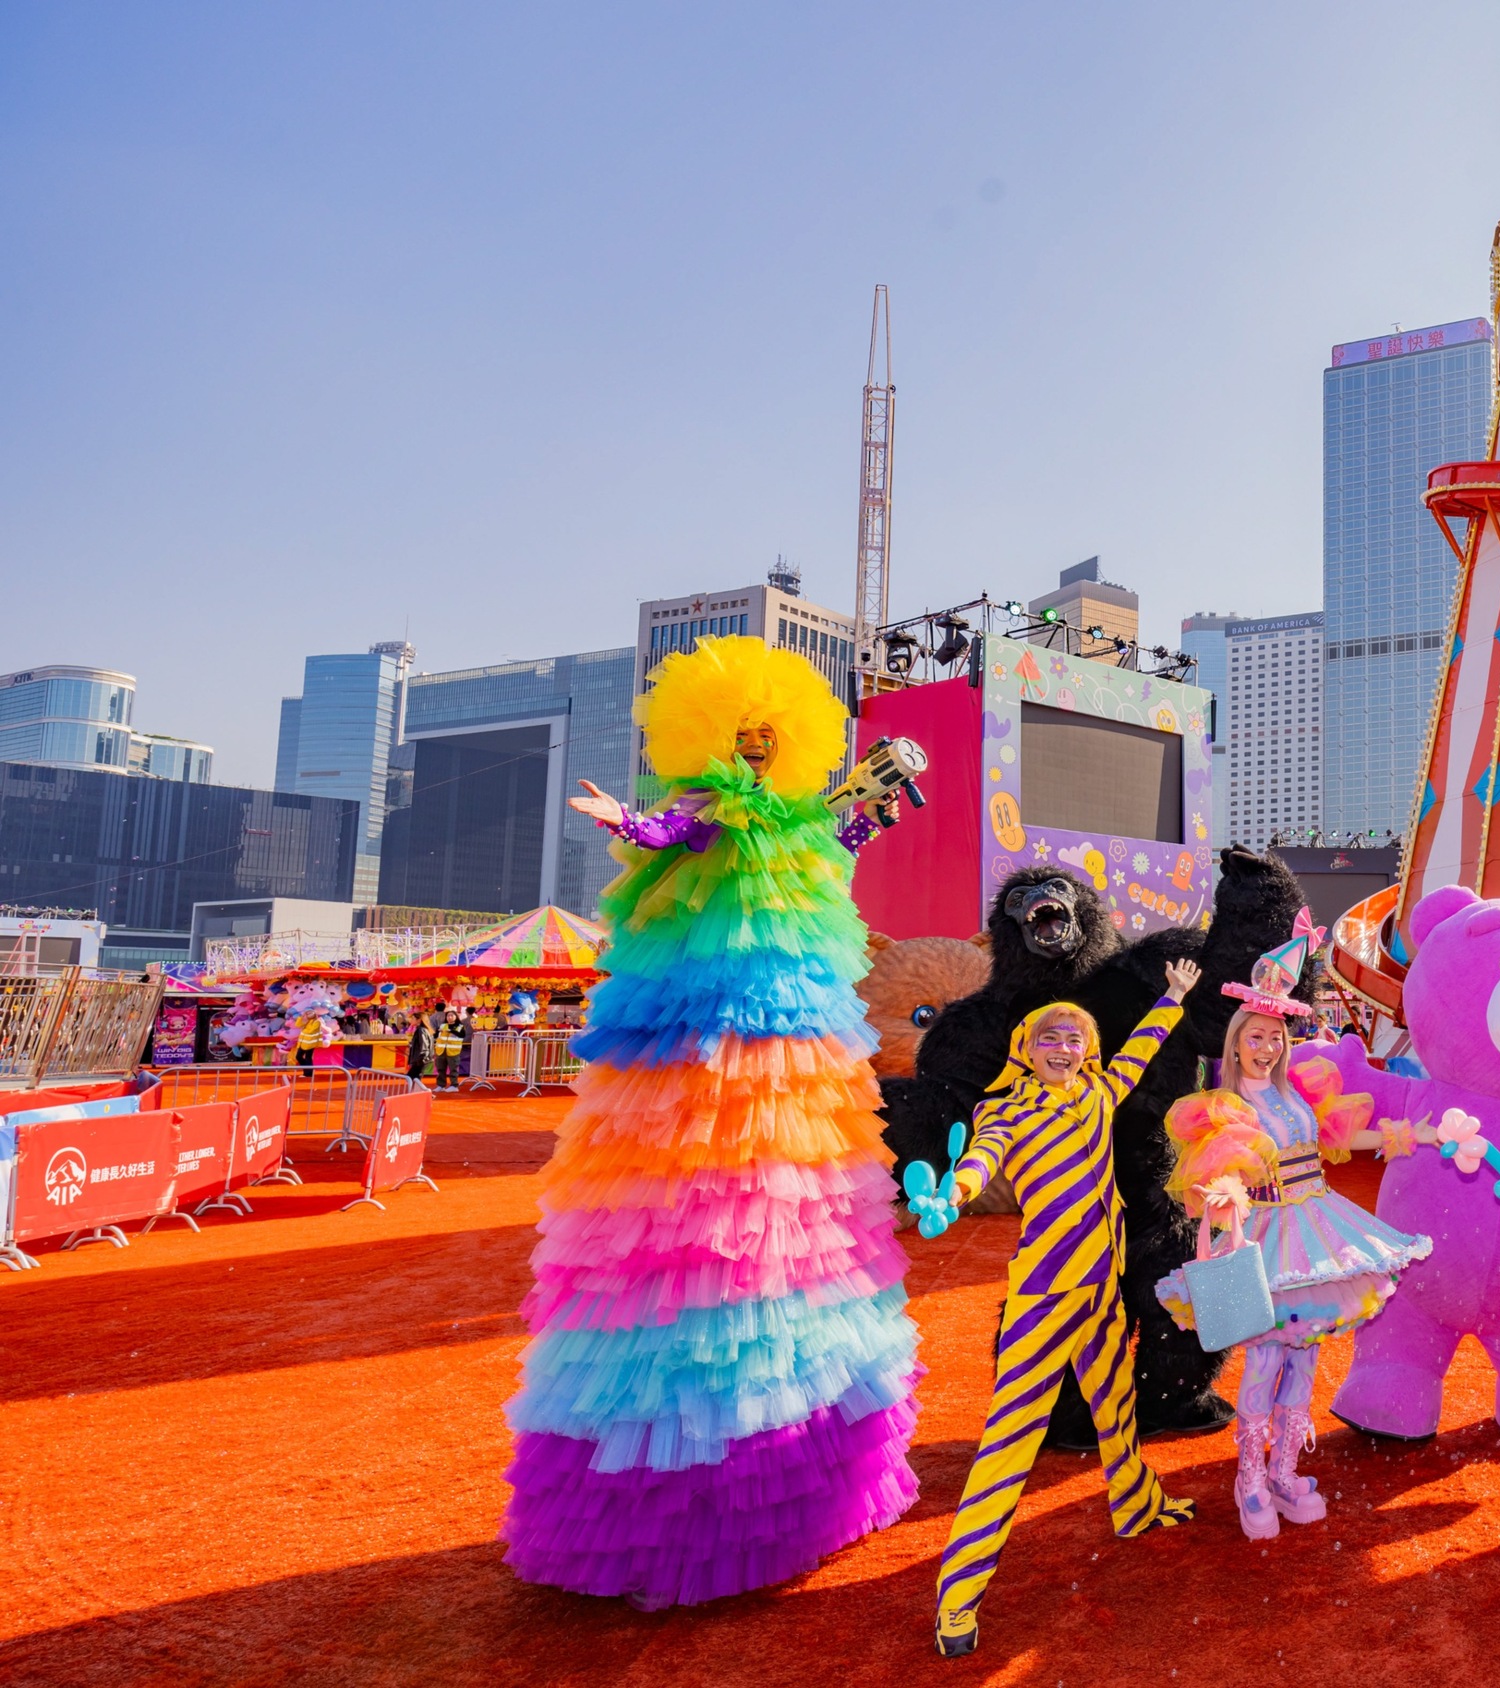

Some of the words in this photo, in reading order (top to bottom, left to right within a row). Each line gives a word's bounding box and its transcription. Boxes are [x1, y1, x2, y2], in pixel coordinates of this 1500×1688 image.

[1367, 330, 1444, 360] 聖誕快樂
[1231, 626, 1256, 635] BANK
[1257, 623, 1268, 632] OF
[1270, 618, 1310, 630] AMERICA
[1127, 882, 1190, 925] cute!
[90, 1161, 156, 1184] 健康長久好生活
[46, 1183, 83, 1206] AIA
